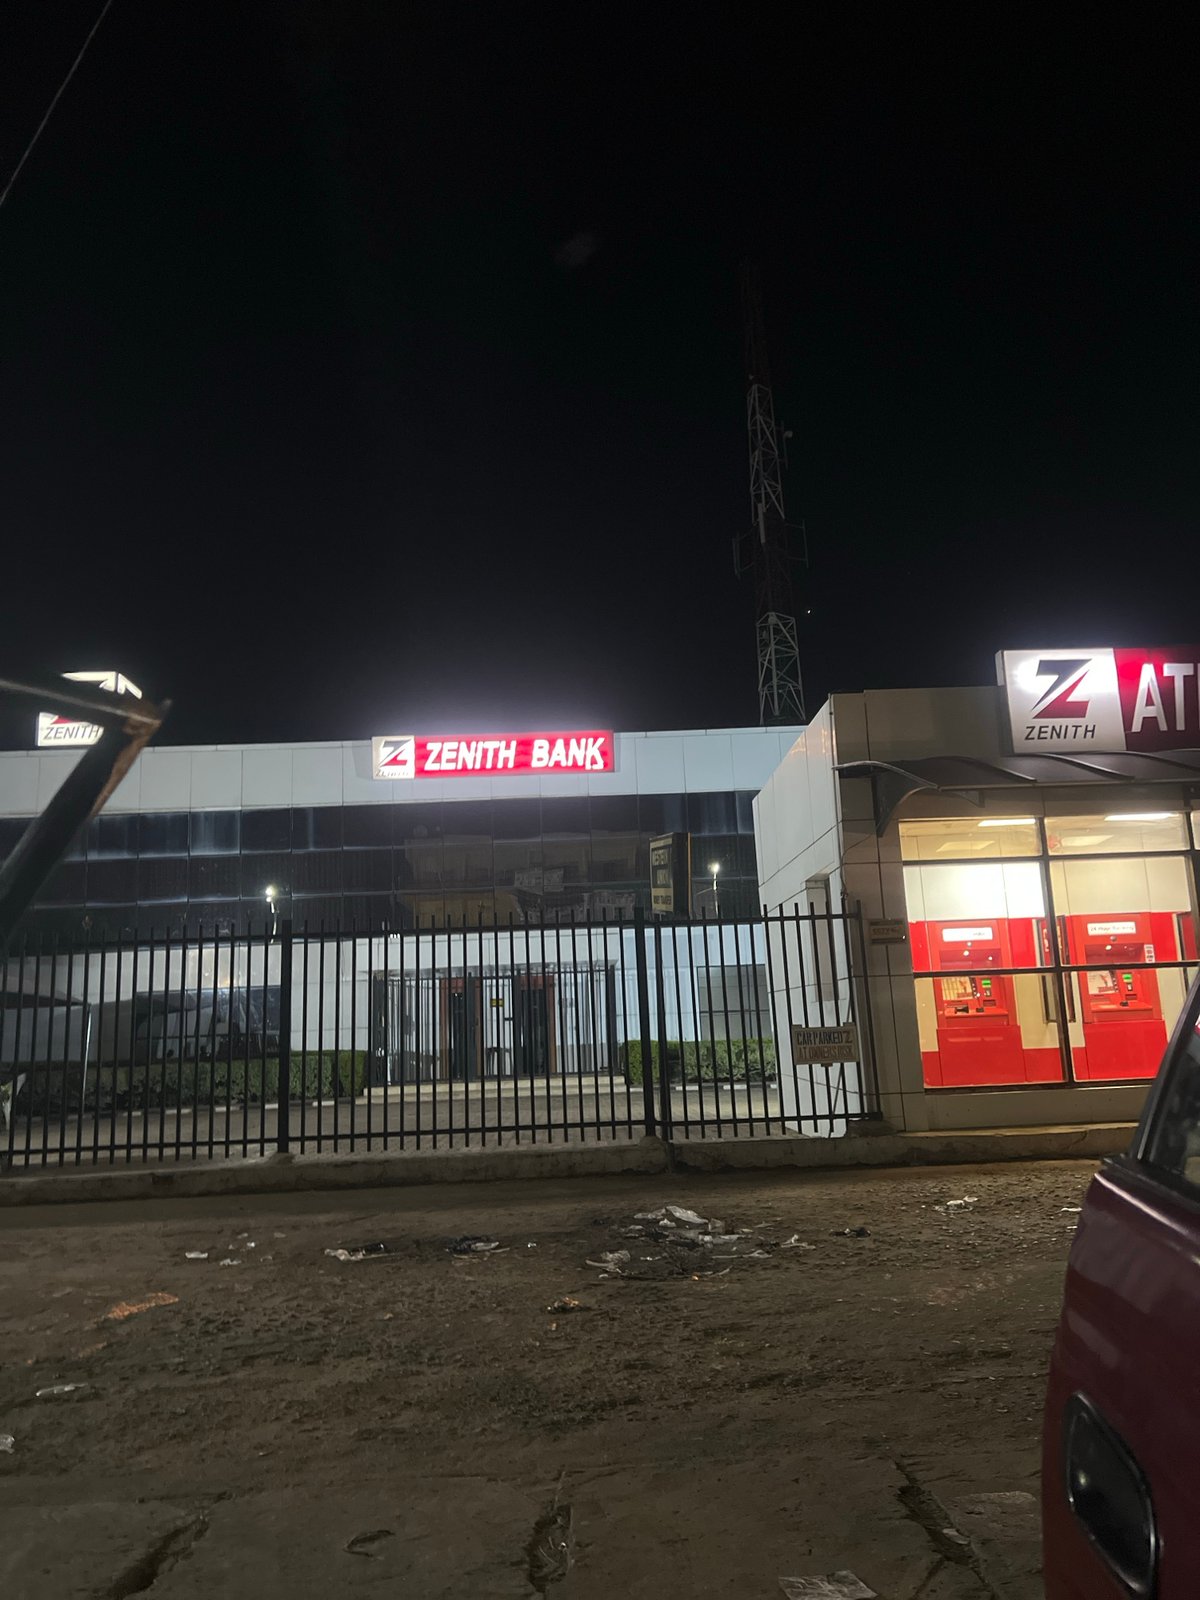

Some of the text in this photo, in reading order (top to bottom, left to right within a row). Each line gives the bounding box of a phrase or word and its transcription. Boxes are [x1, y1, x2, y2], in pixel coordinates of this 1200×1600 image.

[1131, 662, 1200, 733] AT
[43, 724, 101, 741] ZENITH
[1024, 724, 1097, 741] ZENITH
[423, 736, 607, 771] ZENITH BANK
[797, 1031, 812, 1046] CAR
[813, 1030, 843, 1046] PARKED
